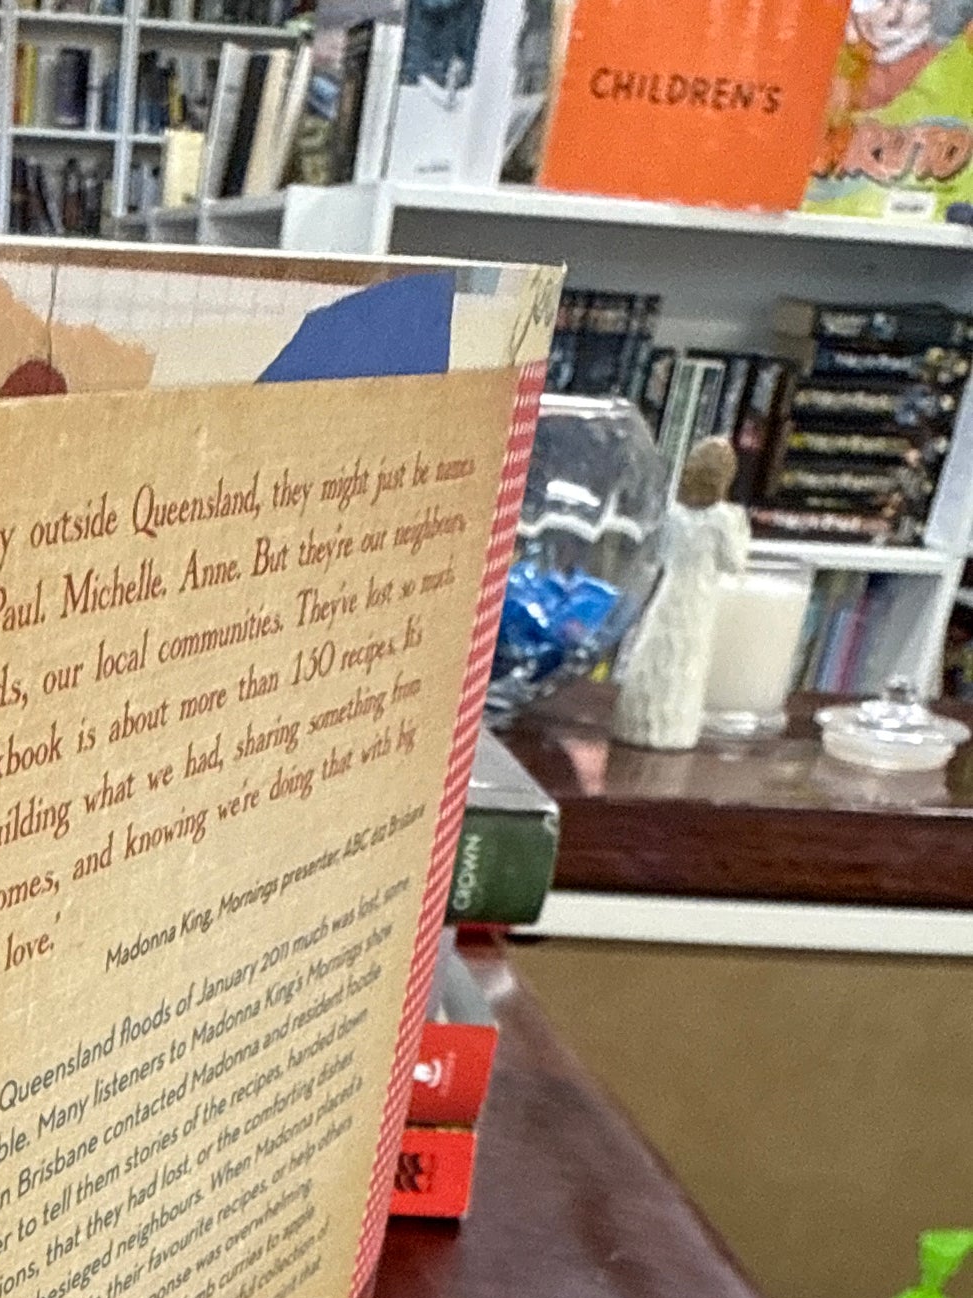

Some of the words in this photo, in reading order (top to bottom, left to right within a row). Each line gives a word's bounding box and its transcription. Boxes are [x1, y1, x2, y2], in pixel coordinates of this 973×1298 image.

[589, 67, 783, 115] CHILDREN'S
[28, 492, 118, 549] outside
[129, 471, 260, 539] Queensland,
[271, 466, 313, 515] they
[320, 456, 370, 508] might
[374, 454, 407, 502] just
[412, 448, 430, 484] be
[60, 558, 166, 619] Michelle.
[179, 550, 240, 592] Anne.
[252, 535, 290, 576] But
[297, 522, 354, 573] they're
[360, 525, 387, 552] our
[42, 656, 83, 694] our
[95, 626, 149, 679] local
[157, 603, 283, 663] communities.
[293, 579, 358, 629] They've
[76, 716, 97, 754] is
[108, 692, 169, 744] about
[178, 683, 227, 721] more
[236, 661, 280, 703] than
[292, 639, 337, 685] 150
[72, 828, 114, 882] and
[124, 805, 208, 861] knowing
[216, 779, 260, 823] we're
[268, 763, 315, 802] doing
[320, 741, 354, 781] that
[82, 765, 135, 816] what
[146, 760, 173, 793] we
[184, 731, 223, 779] had,
[234, 714, 300, 761] sharing
[104, 919, 177, 972] Madonna
[119, 996, 172, 1047] floods
[16, 1131, 98, 1198] Brisbane
[102, 1069, 188, 1146] contacted
[36, 1091, 89, 1140] Many
[92, 1048, 165, 1107] listeners
[17, 1212, 37, 1243] to
[41, 1181, 72, 1227] tell
[75, 1160, 120, 1205] them
[124, 1123, 178, 1174] stories
[45, 1223, 80, 1268] that
[85, 1200, 122, 1241] they
[126, 1168, 158, 1214] had
